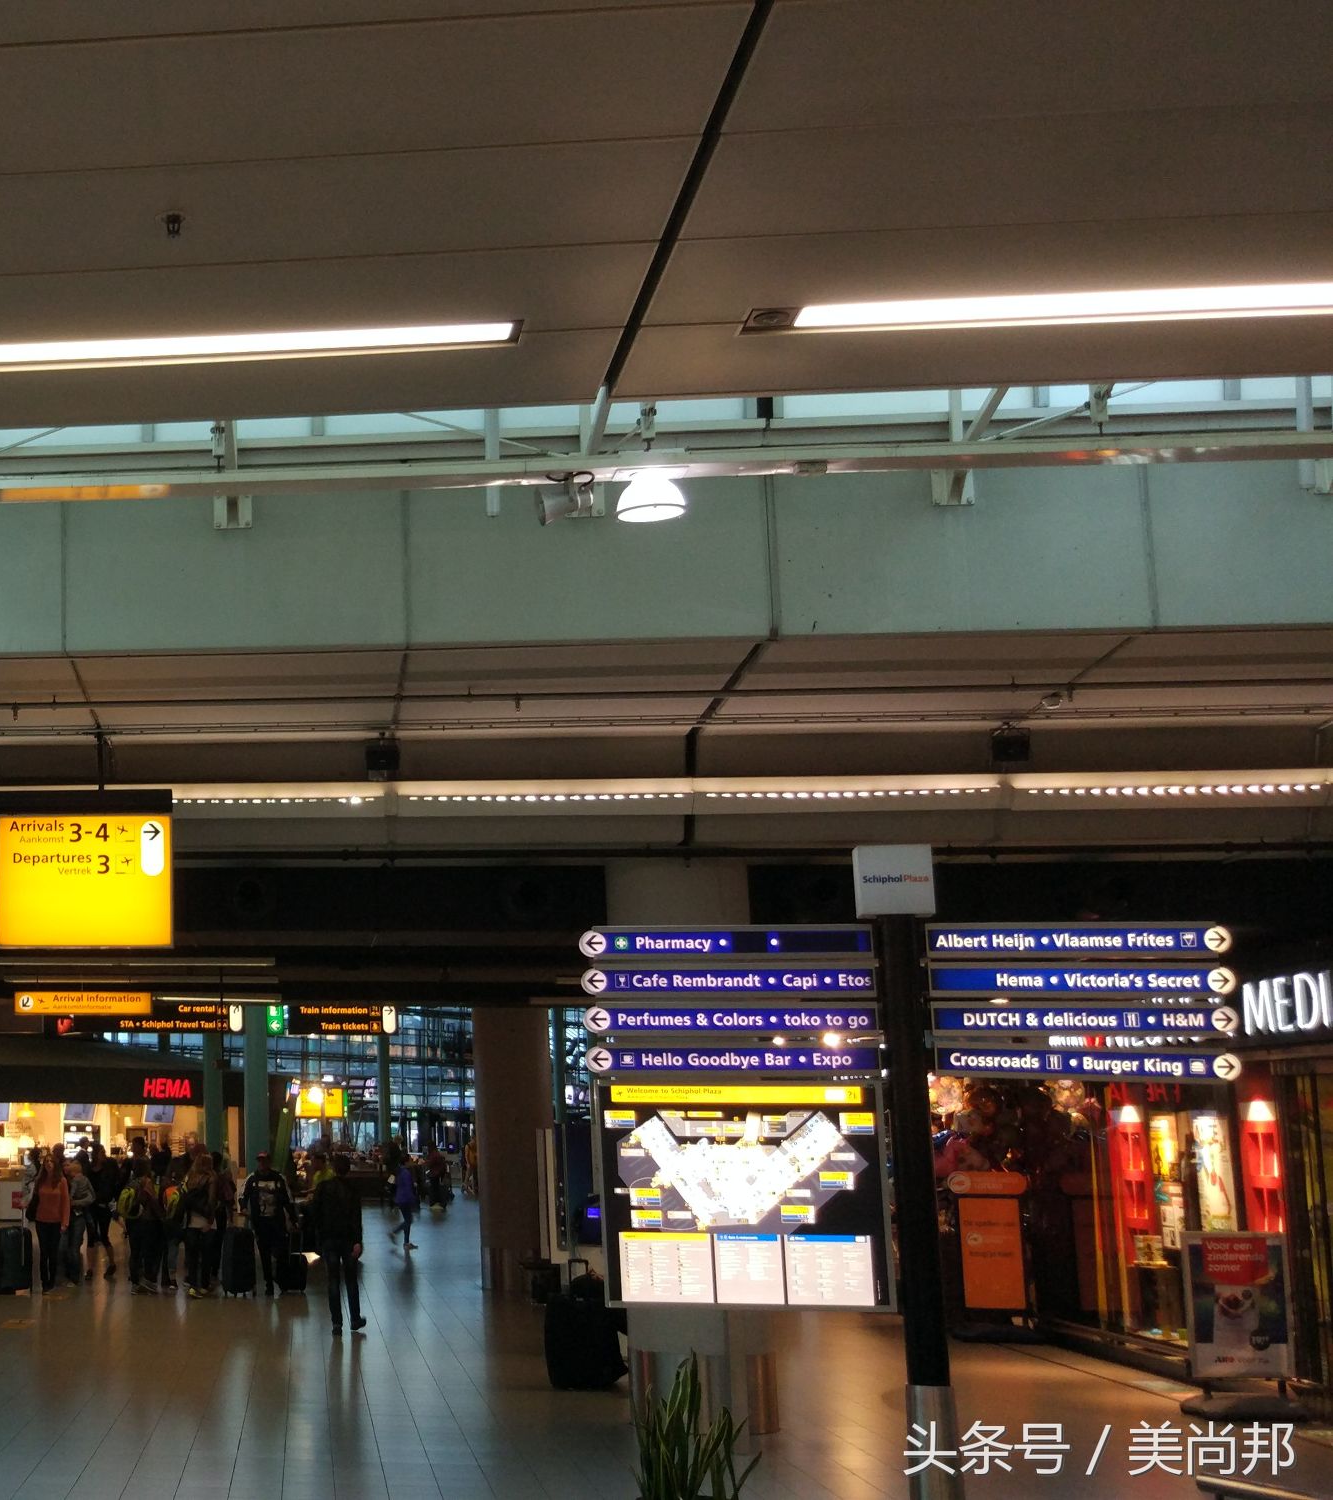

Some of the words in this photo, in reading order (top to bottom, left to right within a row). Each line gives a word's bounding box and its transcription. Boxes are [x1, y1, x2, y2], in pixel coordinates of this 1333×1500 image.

[10, 820, 65, 833] Arrivals
[69, 823, 110, 843] 3-4
[19, 835, 64, 844] Aankomst
[13, 852, 92, 866] Departures
[97, 854, 110, 875] 3
[58, 867, 92, 876] Vertrek
[635, 936, 712, 952] Pharmacy
[935, 933, 988, 949] Albert
[991, 932, 1035, 951] Heijn
[1052, 932, 1123, 949] Vlaamse
[1127, 931, 1175, 947] Frites
[632, 974, 668, 988] Cafe
[673, 973, 761, 988] Rembrandt
[782, 973, 818, 990] Capi
[838, 973, 872, 988] Etos
[995, 972, 1044, 989] Hema
[1147, 972, 1201, 989] Secret
[52, 994, 85, 1003] Arrival
[86, 994, 142, 1003] information
[178, 1005, 191, 1013] Car
[192, 1004, 216, 1013] rental
[300, 1006, 320, 1015] Train
[323, 1005, 368, 1015] information
[119, 1020, 134, 1029] STA
[142, 1020, 175, 1030] Schiphol
[176, 1020, 198, 1029] Travel
[200, 1020, 216, 1028] Taxi
[321, 1022, 341, 1031] Train
[342, 1021, 369, 1031] tickets
[617, 1011, 693, 1026] Perfumes
[696, 1012, 708, 1026] &
[712, 1011, 763, 1026] Colors
[783, 1011, 821, 1026] toko
[825, 1013, 843, 1026] to
[848, 1015, 869, 1030] go
[962, 1012, 1022, 1028] DUTCH
[1025, 1012, 1039, 1027] &
[1043, 1011, 1118, 1028] delicious
[1162, 1013, 1205, 1027] H&M
[641, 1052, 685, 1067] Hello
[688, 1052, 760, 1070] Goodbye
[765, 1053, 791, 1067] Bar
[812, 1053, 853, 1071] Expo
[949, 1053, 1041, 1069] Crossroads
[1082, 1057, 1140, 1076] Burger
[1144, 1057, 1183, 1076] King
[142, 1077, 191, 1099] HEMA
[671, 1087, 701, 1095] Schiphol
[702, 1087, 722, 1095] Plaza
[1206, 1241, 1230, 1251] Voor
[1232, 1243, 1252, 1251] een
[1206, 1252, 1266, 1263] zinderende
[1208, 1263, 1242, 1273] zomer
